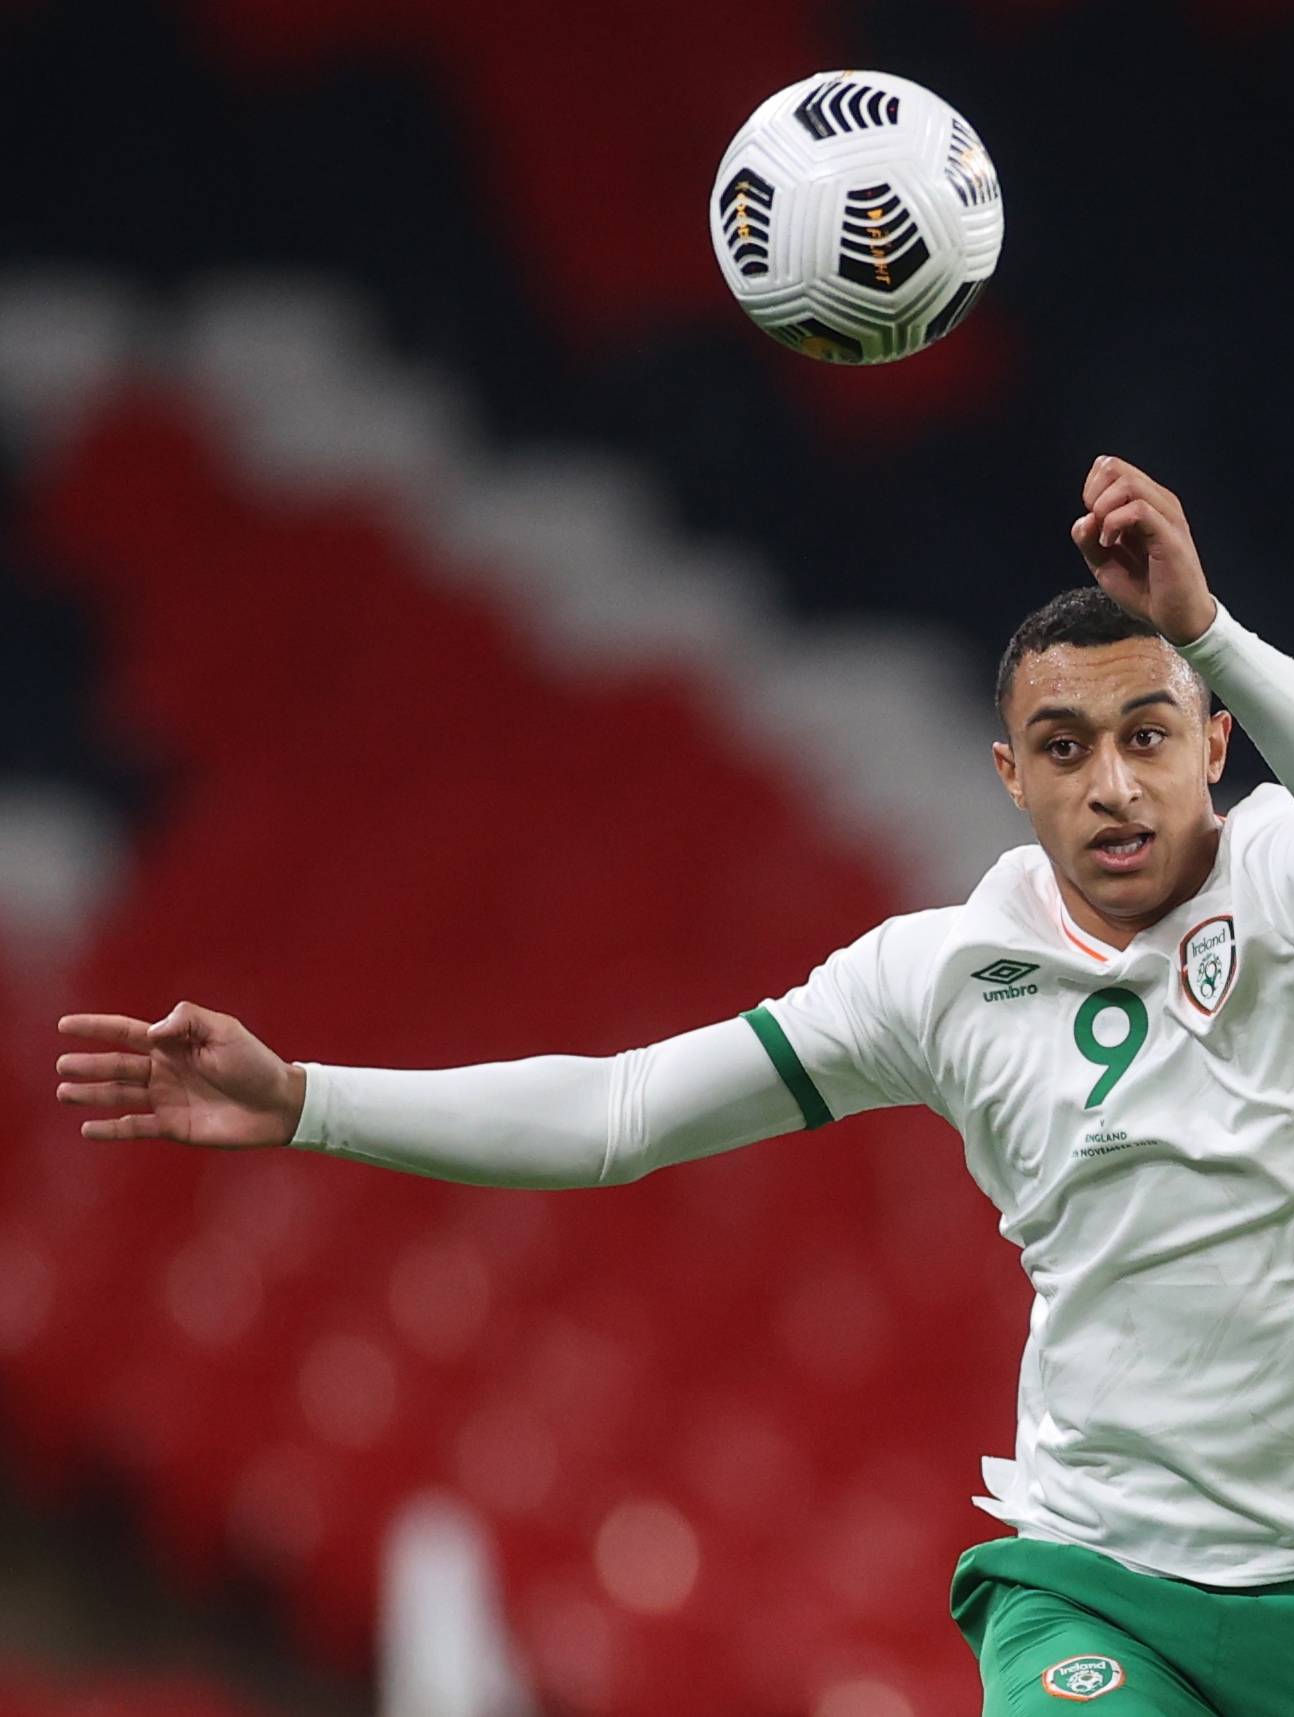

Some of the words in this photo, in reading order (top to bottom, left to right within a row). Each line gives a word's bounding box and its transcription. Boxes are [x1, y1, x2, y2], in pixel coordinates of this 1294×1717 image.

[1192, 928, 1226, 958] Ireland
[983, 984, 1038, 1003] umbro
[1074, 987, 1149, 1110] 9
[1085, 1131, 1128, 1143] ENGLAND
[1059, 1661, 1107, 1676] Ireland
